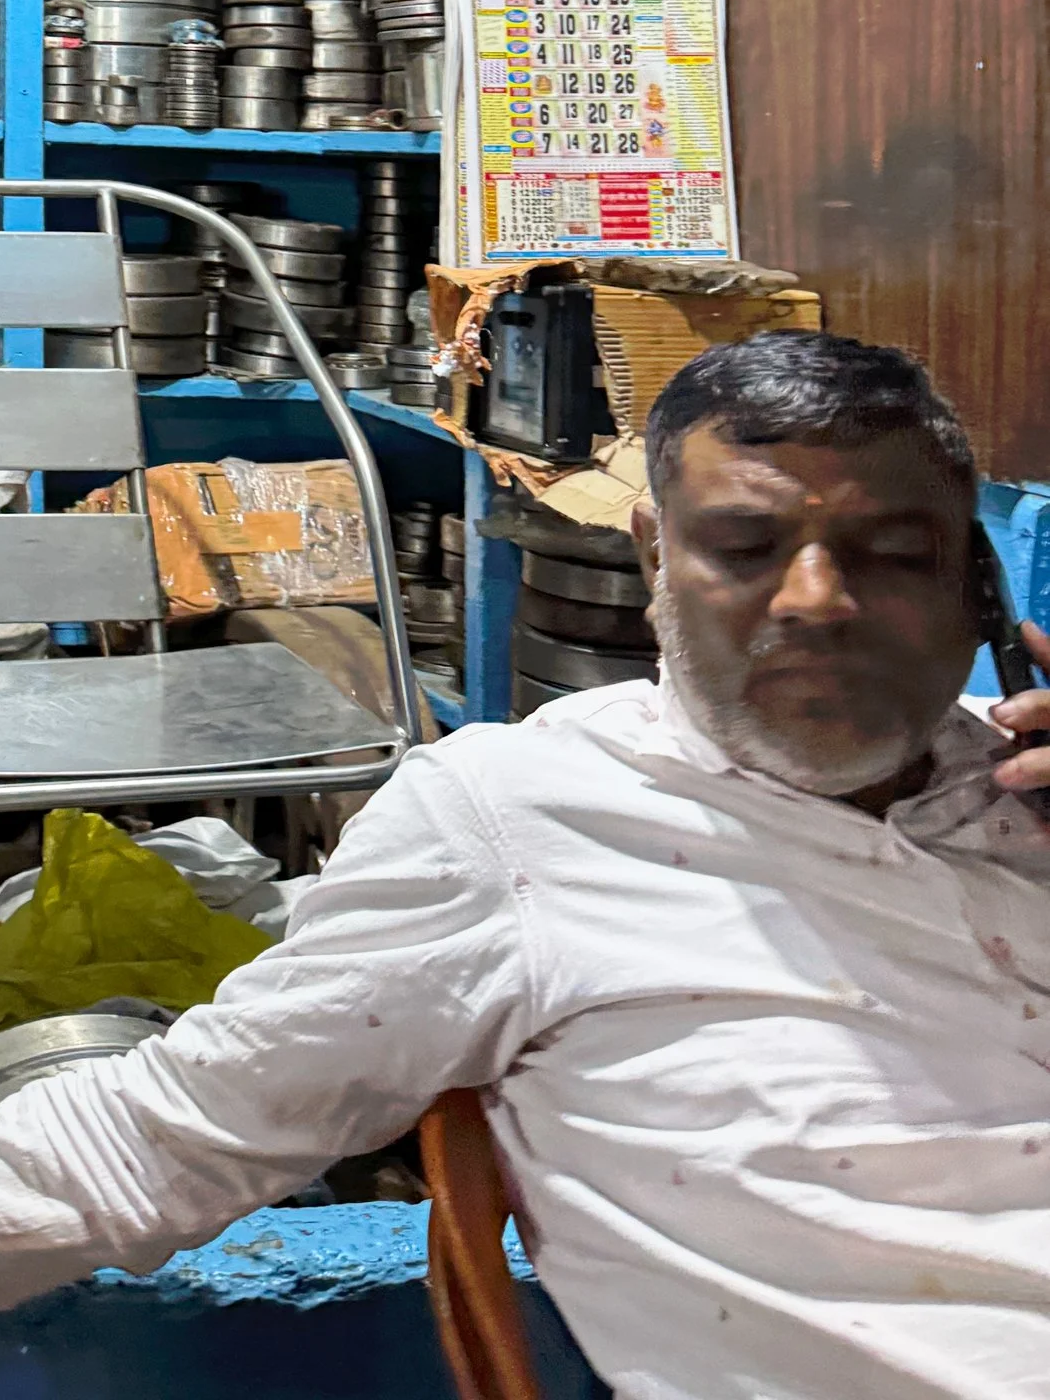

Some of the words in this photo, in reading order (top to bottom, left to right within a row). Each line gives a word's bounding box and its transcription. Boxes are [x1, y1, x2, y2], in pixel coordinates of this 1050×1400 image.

[535, 13, 545, 34] 3
[559, 14, 575, 35] 10
[587, 15, 600, 30] 17
[611, 14, 631, 35] 24
[537, 43, 547, 64] 4
[562, 43, 575, 64] 11
[588, 44, 602, 59] 18
[612, 44, 633, 65] 25
[562, 73, 579, 94] 12
[588, 73, 605, 94] 19
[614, 73, 635, 94] 26
[540, 104, 550, 125] 6
[566, 103, 578, 118] 13
[588, 103, 607, 124] 20
[619, 104, 634, 119] 27
[542, 133, 551, 153] 7
[567, 134, 579, 149] 14
[591, 133, 609, 153] 21
[618, 132, 639, 153] 28
